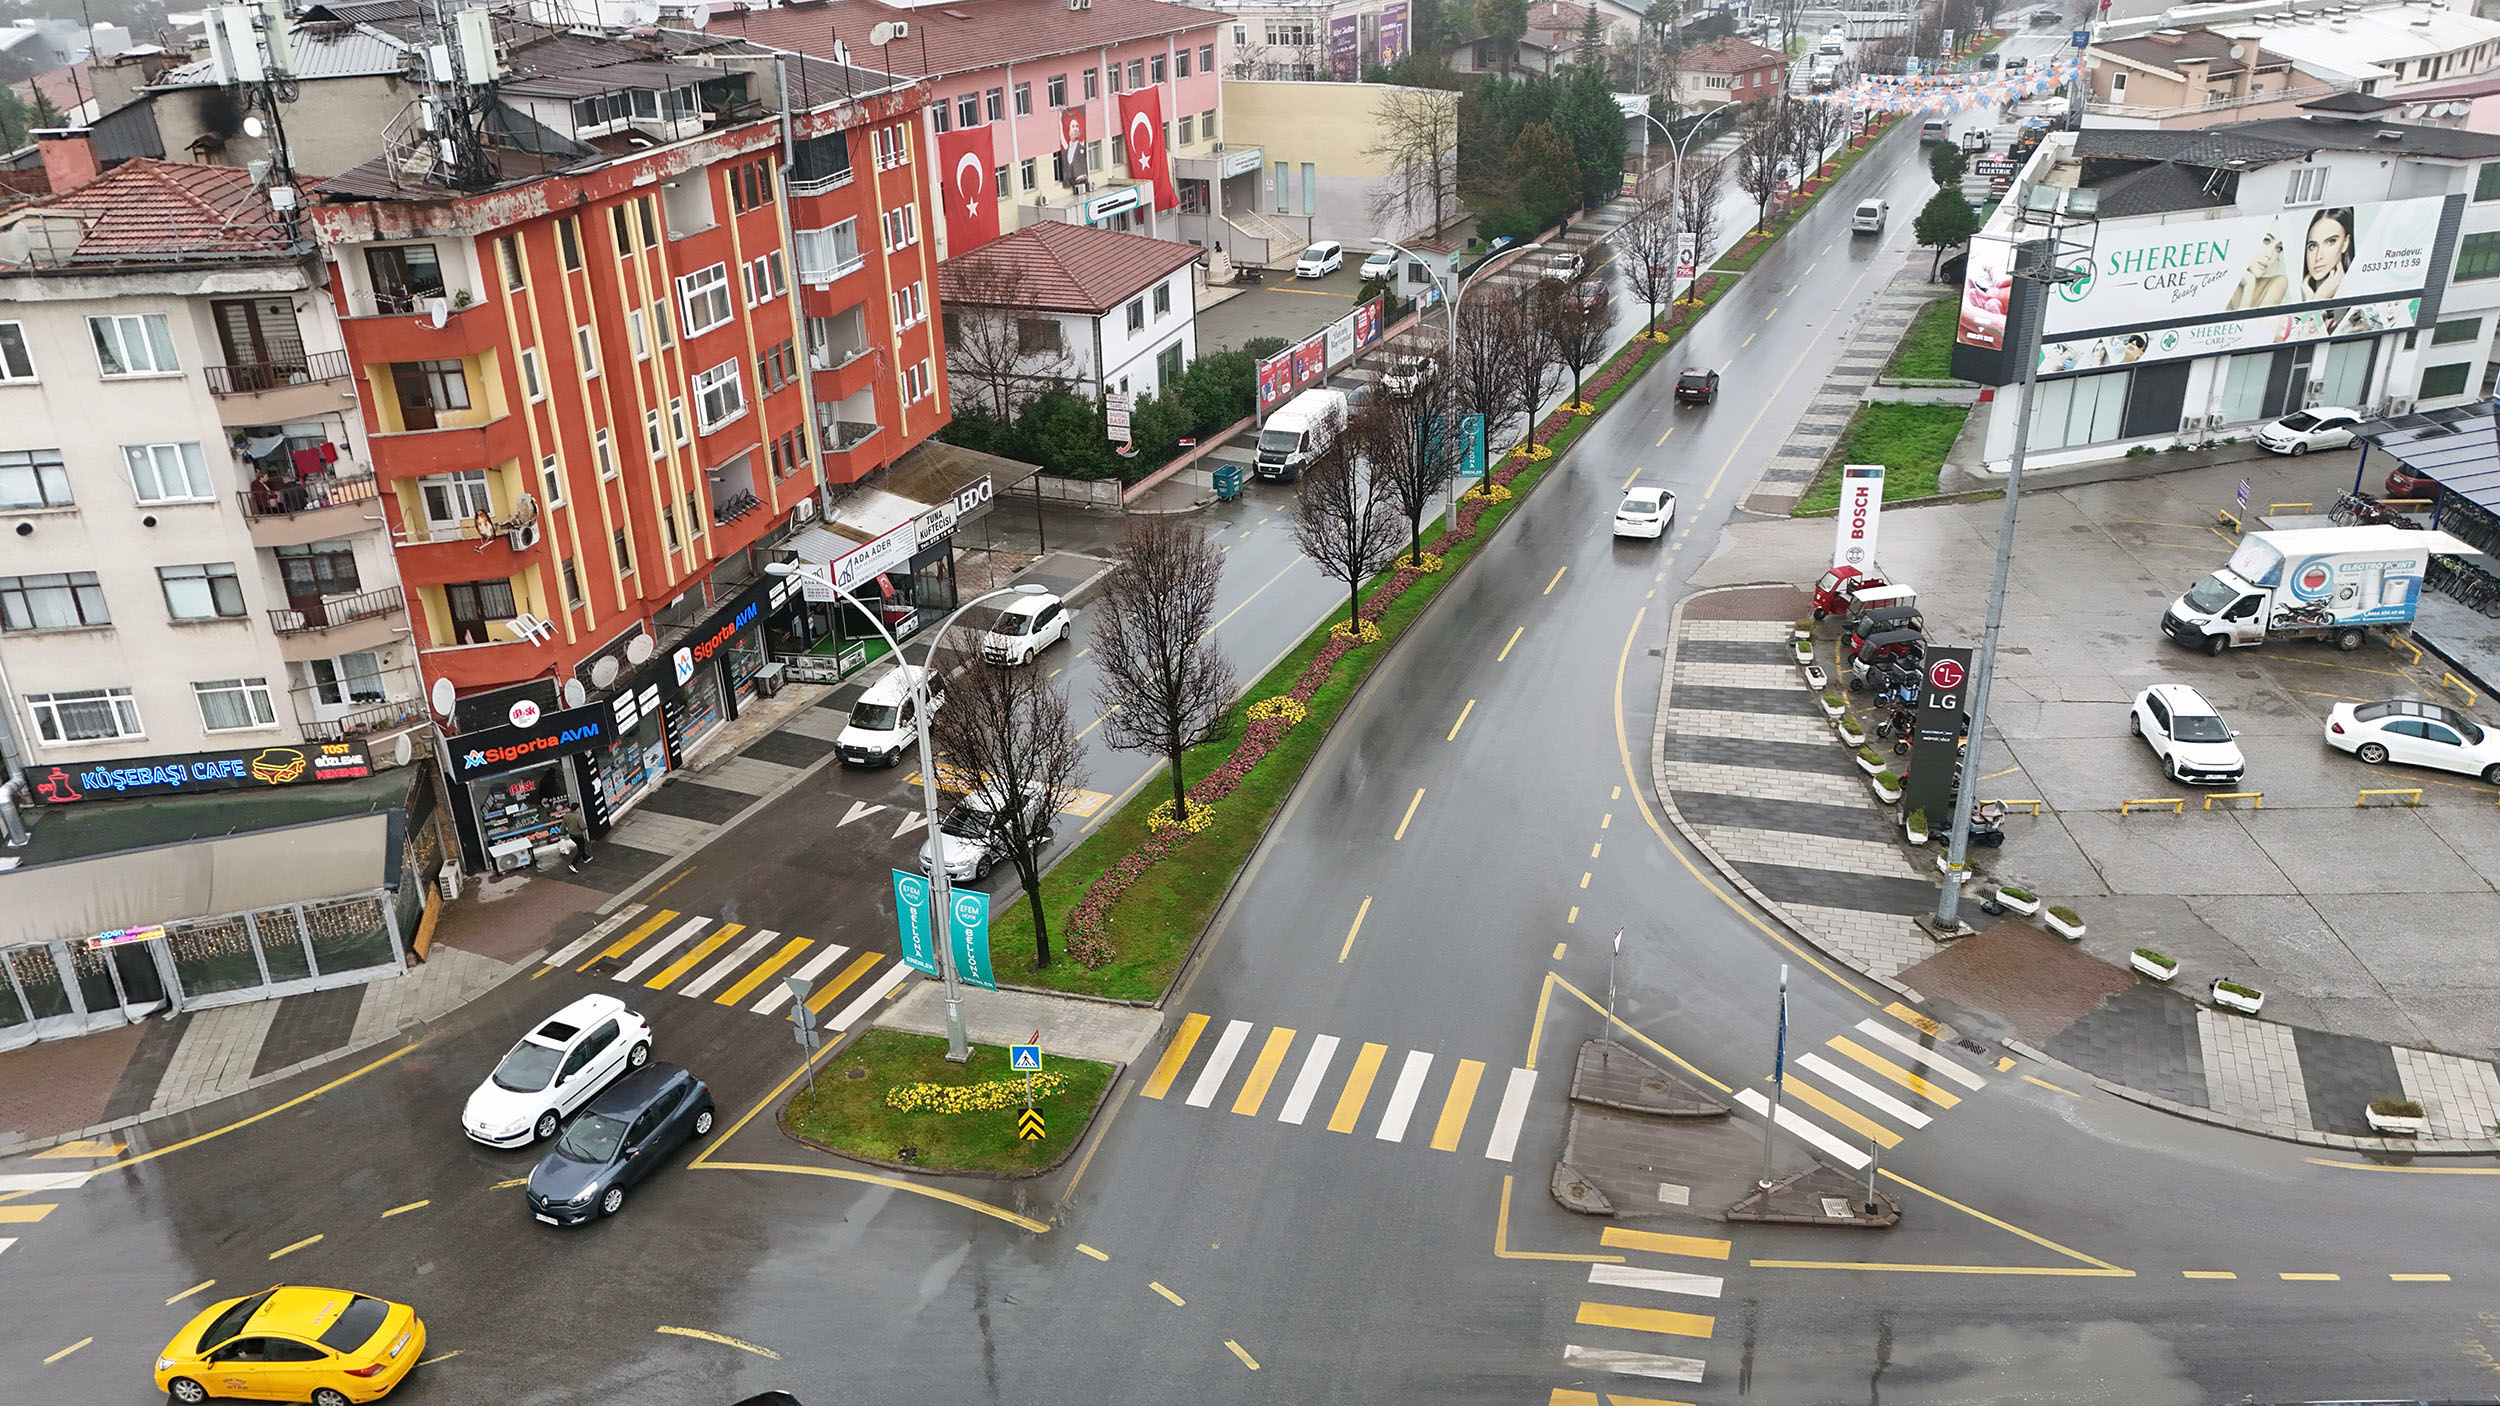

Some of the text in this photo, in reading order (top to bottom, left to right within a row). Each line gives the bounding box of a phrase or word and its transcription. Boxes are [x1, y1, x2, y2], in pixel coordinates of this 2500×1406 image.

[2107, 238, 2230, 276] SHEREEN
[2384, 247, 2423, 260] Randevu:
[2361, 258, 2421, 273] 0533 371 13 59
[2143, 270, 2189, 291] CARE
[2171, 268, 2229, 304] Beauty Center
[2189, 322, 2244, 340] SHEREEN
[2205, 336, 2225, 346] CARE
[926, 509, 943, 525] TUNA
[1851, 487, 1869, 539] BOSCH
[854, 551, 870, 566] ADA
[872, 538, 892, 556] ADER
[693, 602, 758, 662] Sigorta AVM
[1929, 693, 1957, 709] LG
[321, 743, 350, 755] TOST
[485, 723, 600, 763] Sigorta AVM
[80, 759, 248, 791] KÖŞEBAŞI CAFE
[315, 766, 368, 779] MENEMEN
[902, 884, 920, 896] EFEM
[959, 904, 980, 915] EFEM
[100, 929, 125, 940] open
[910, 906, 922, 958] BELLONA
[964, 928, 980, 979] BELLONA
